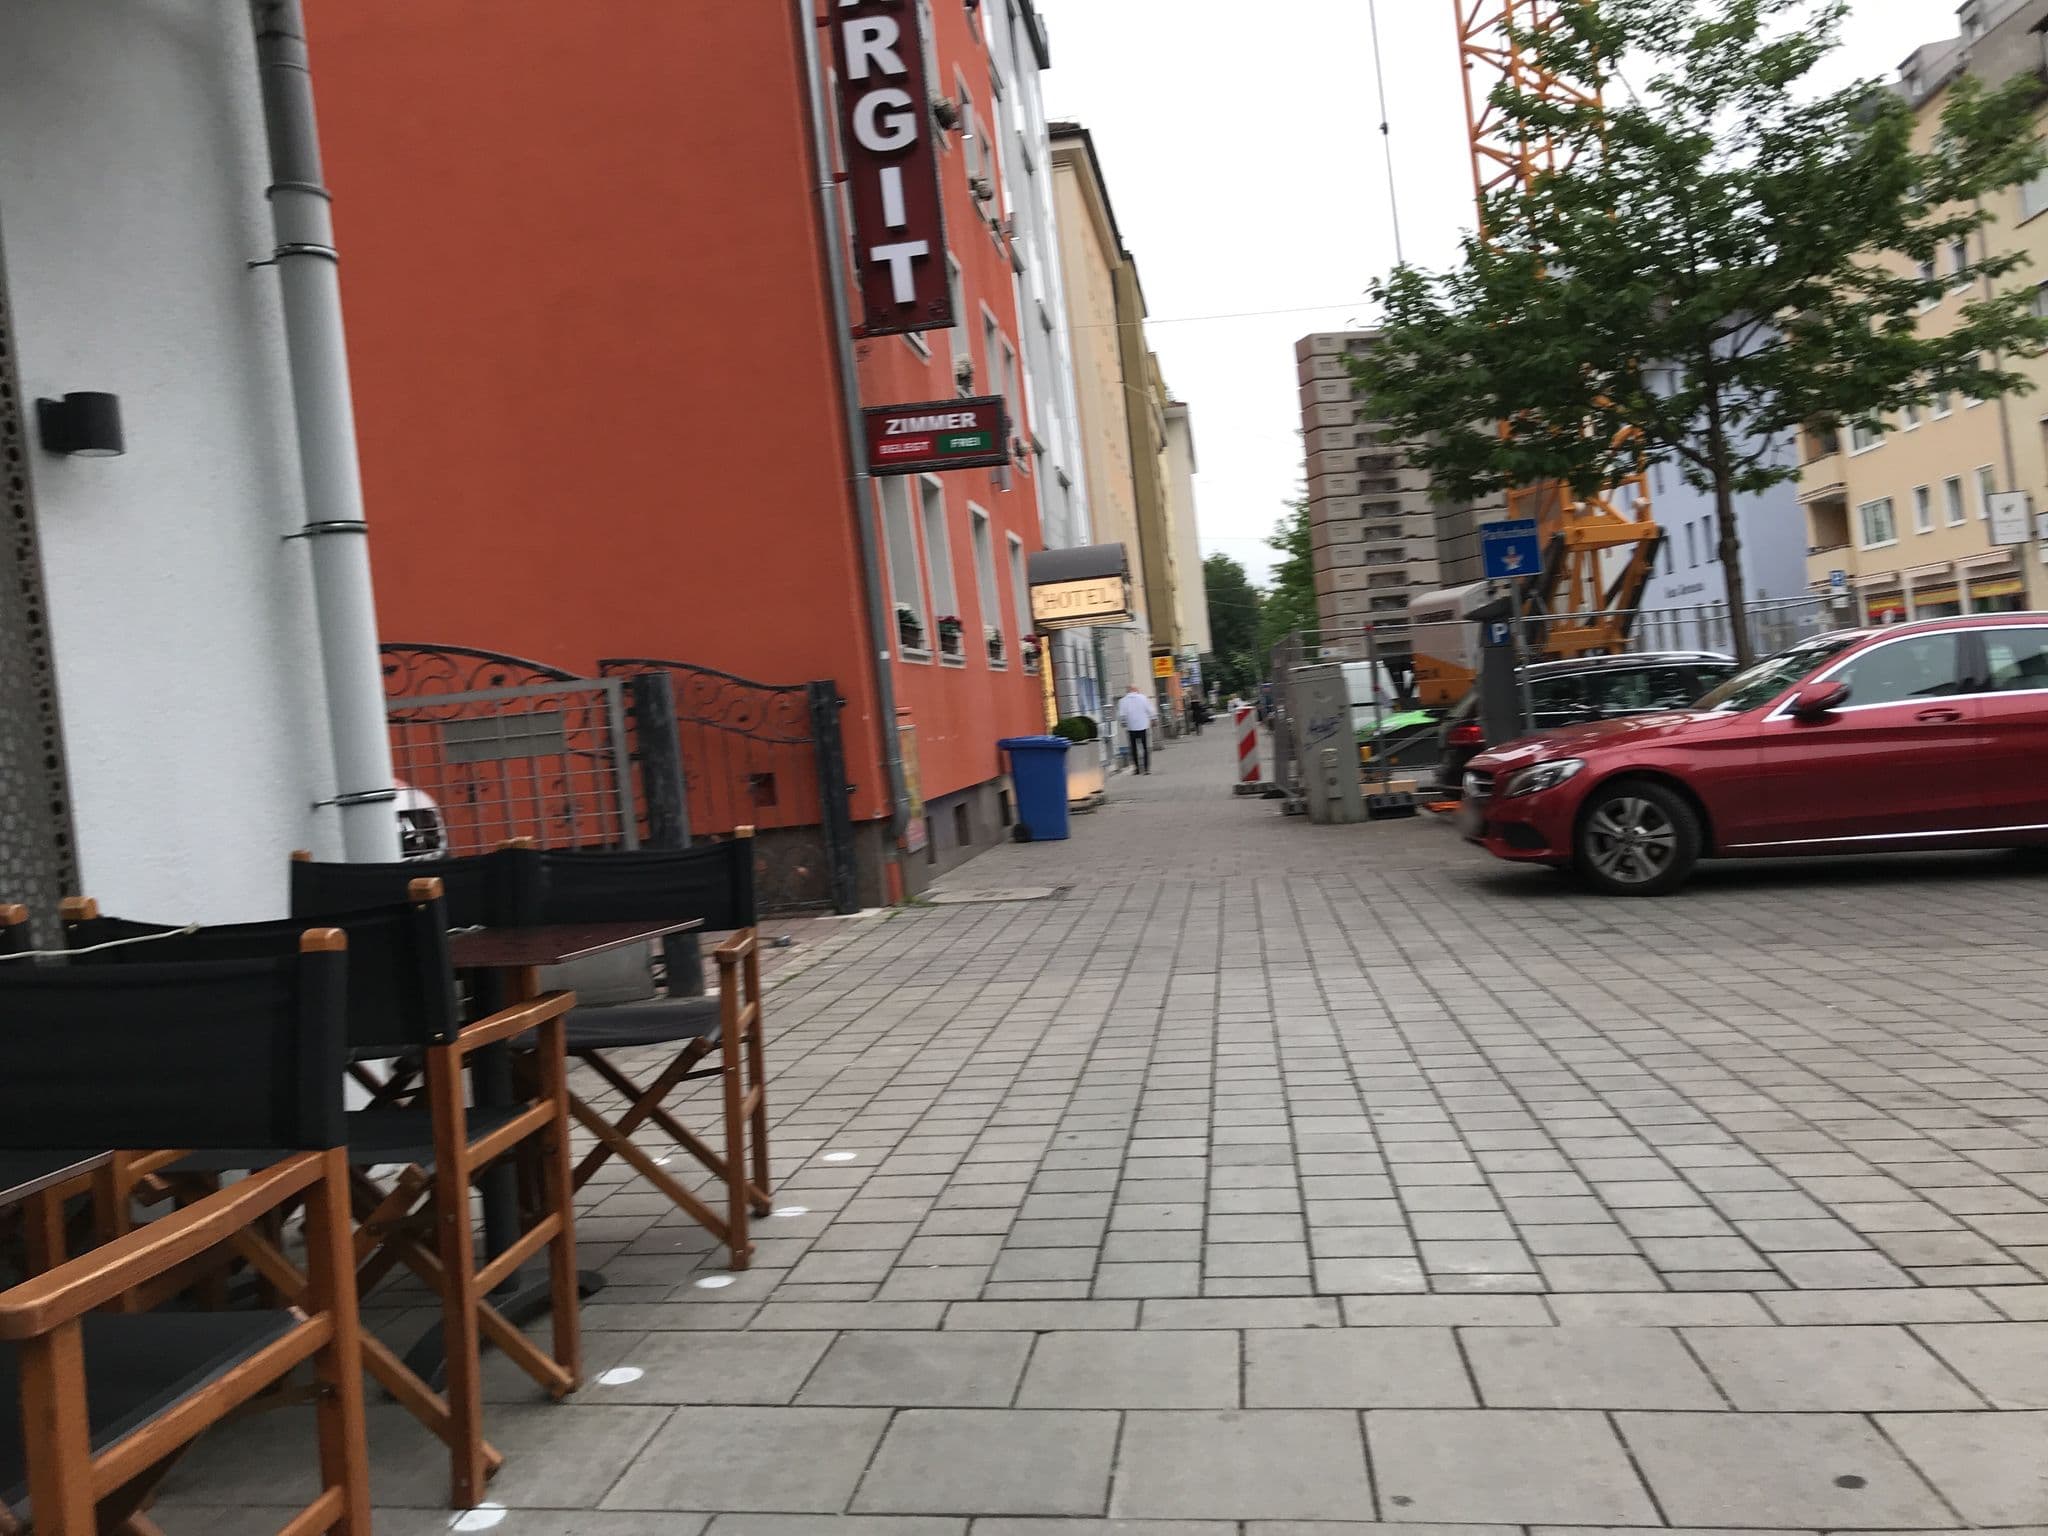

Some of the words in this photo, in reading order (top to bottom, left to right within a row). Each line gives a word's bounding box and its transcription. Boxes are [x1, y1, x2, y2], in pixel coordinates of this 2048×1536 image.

[838, 0, 928, 303] RGIT
[885, 412, 977, 435] ZIMMER
[950, 437, 981, 449] FREI
[1042, 588, 1115, 609] HOTEL
[1491, 623, 1508, 643] P
